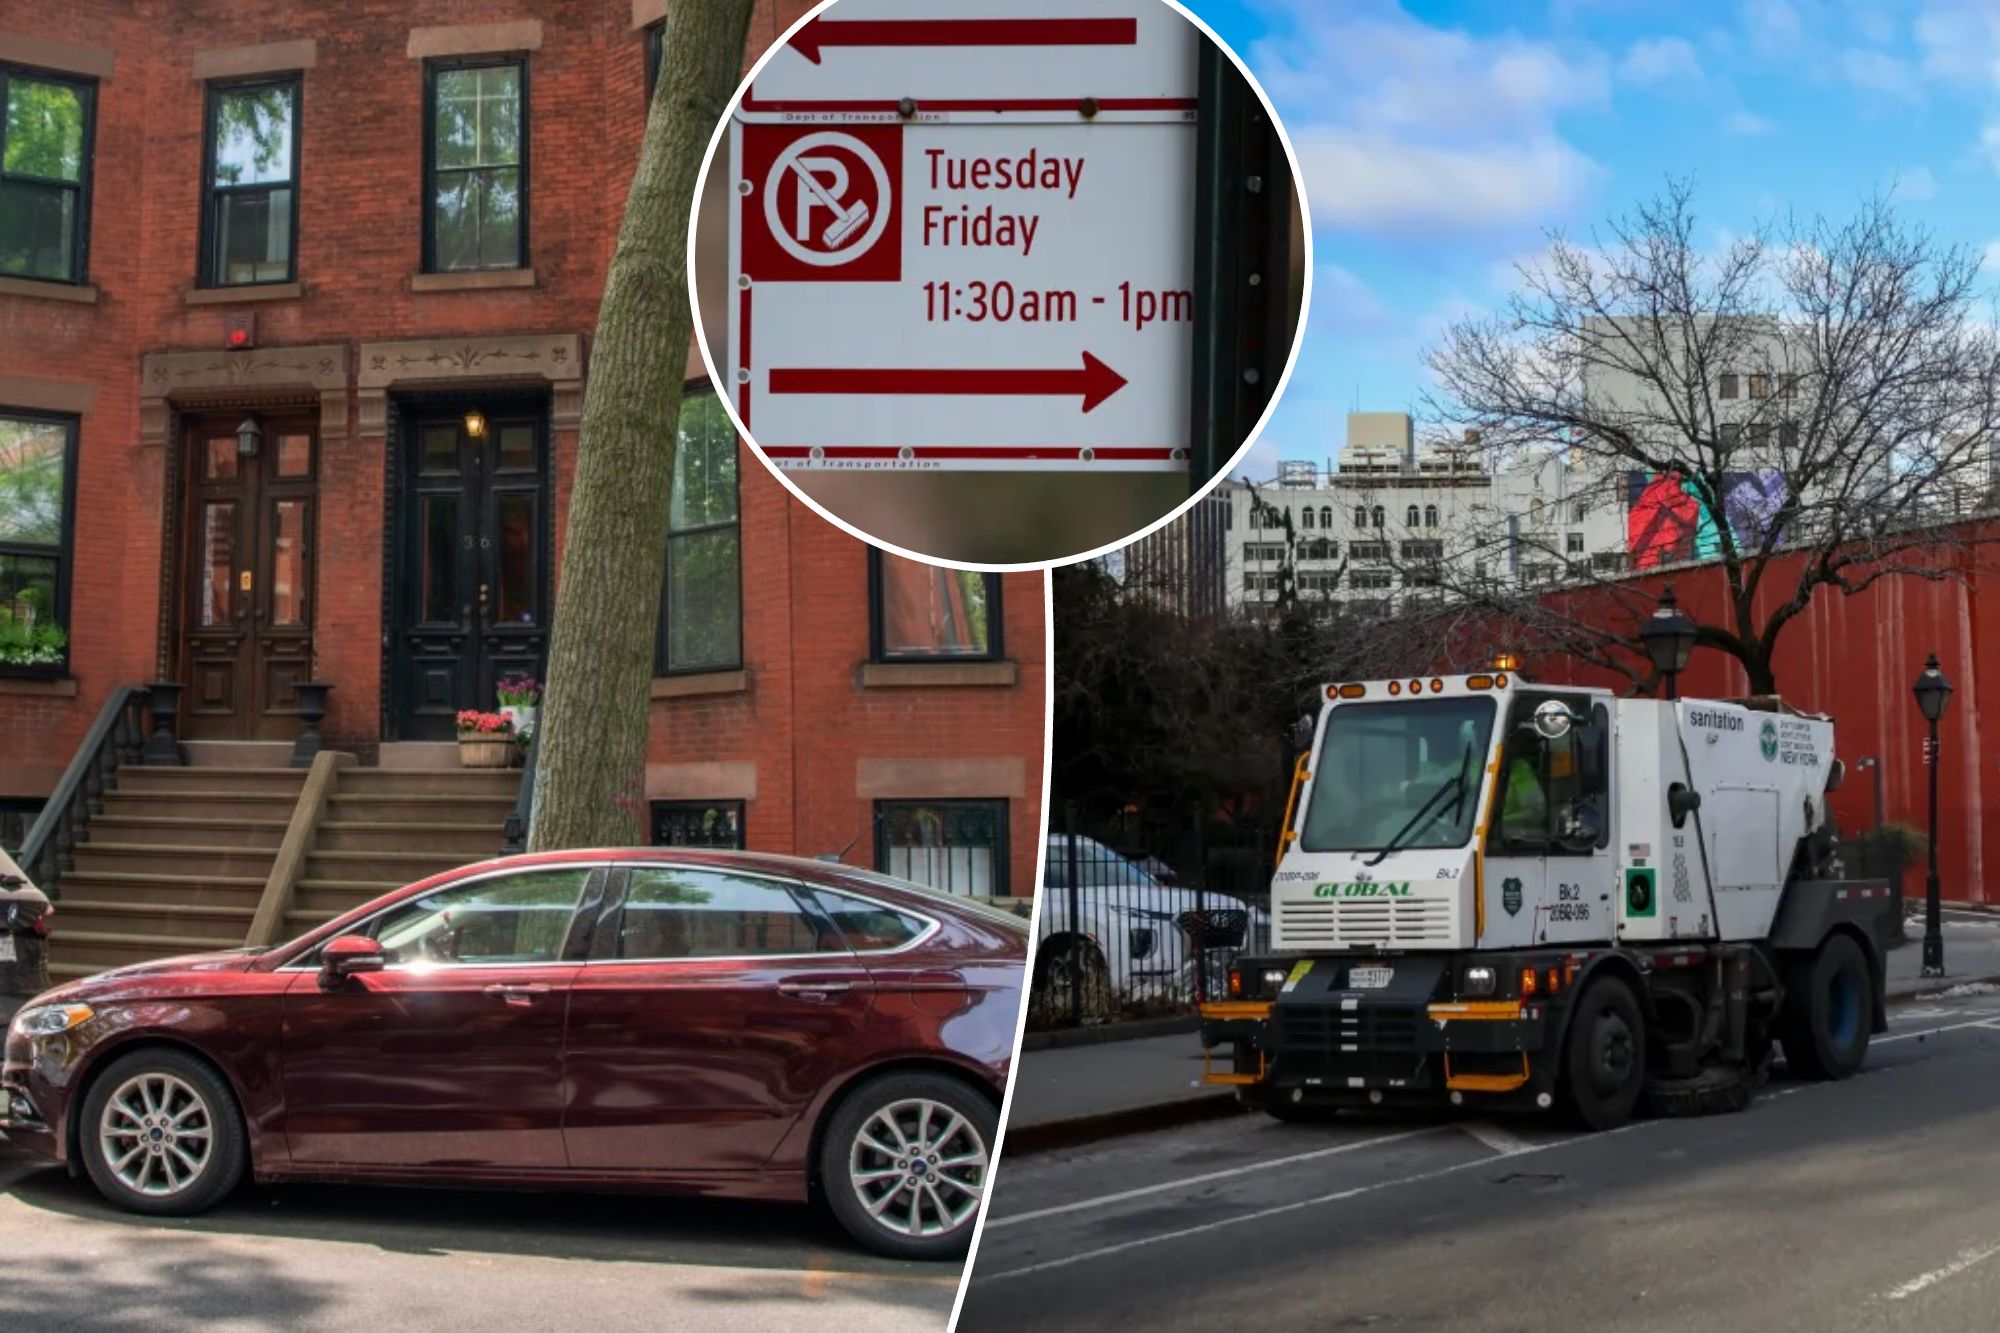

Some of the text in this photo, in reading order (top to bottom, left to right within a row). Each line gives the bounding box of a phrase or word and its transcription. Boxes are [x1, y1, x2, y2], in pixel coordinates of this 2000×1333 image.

[786, 113, 816, 122] Dept
[822, 113, 835, 121] of
[925, 148, 1085, 199] Tuesday
[923, 205, 1039, 256] Friday
[923, 281, 1077, 322] 11:30am
[1118, 281, 1193, 331] 1pm
[1690, 710, 1744, 731] sanitation
[1313, 880, 1414, 897] GLOBAL
[1559, 882, 1580, 901] Bk.2
